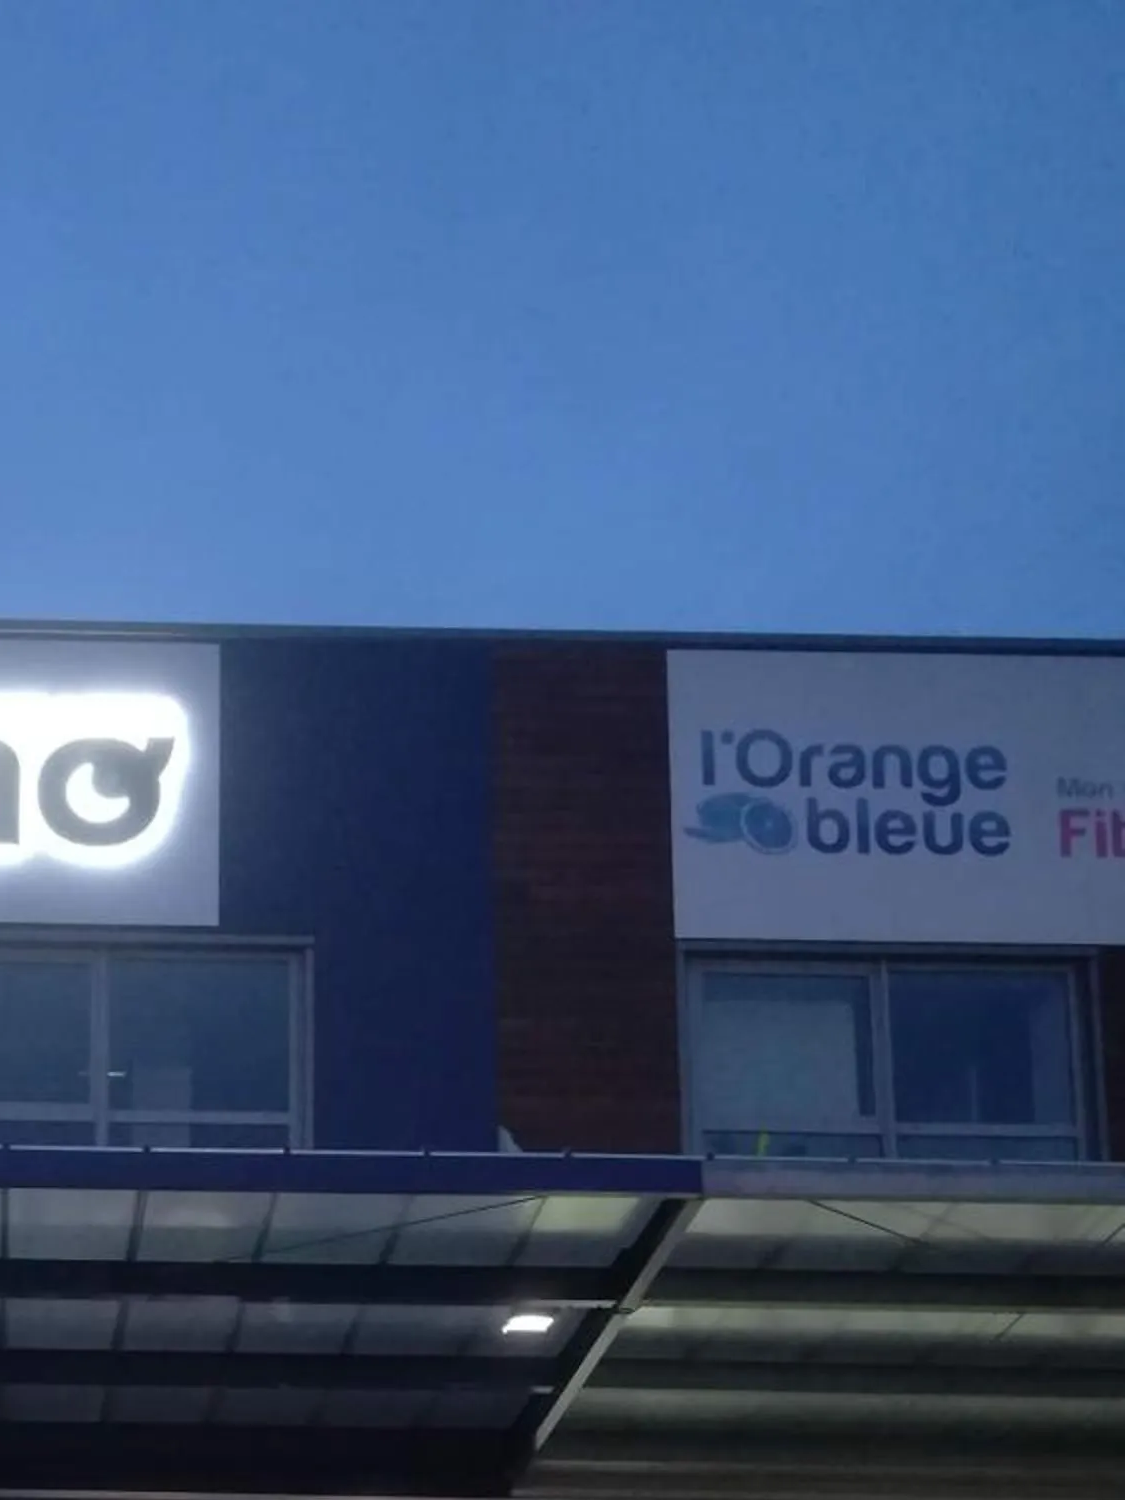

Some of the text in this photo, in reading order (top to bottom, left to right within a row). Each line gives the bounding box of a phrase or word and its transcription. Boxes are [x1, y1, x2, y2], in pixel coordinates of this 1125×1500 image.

[700, 729, 1008, 807] l'Orange
[1057, 776, 1114, 799] Mon
[806, 797, 1012, 856] bleue
